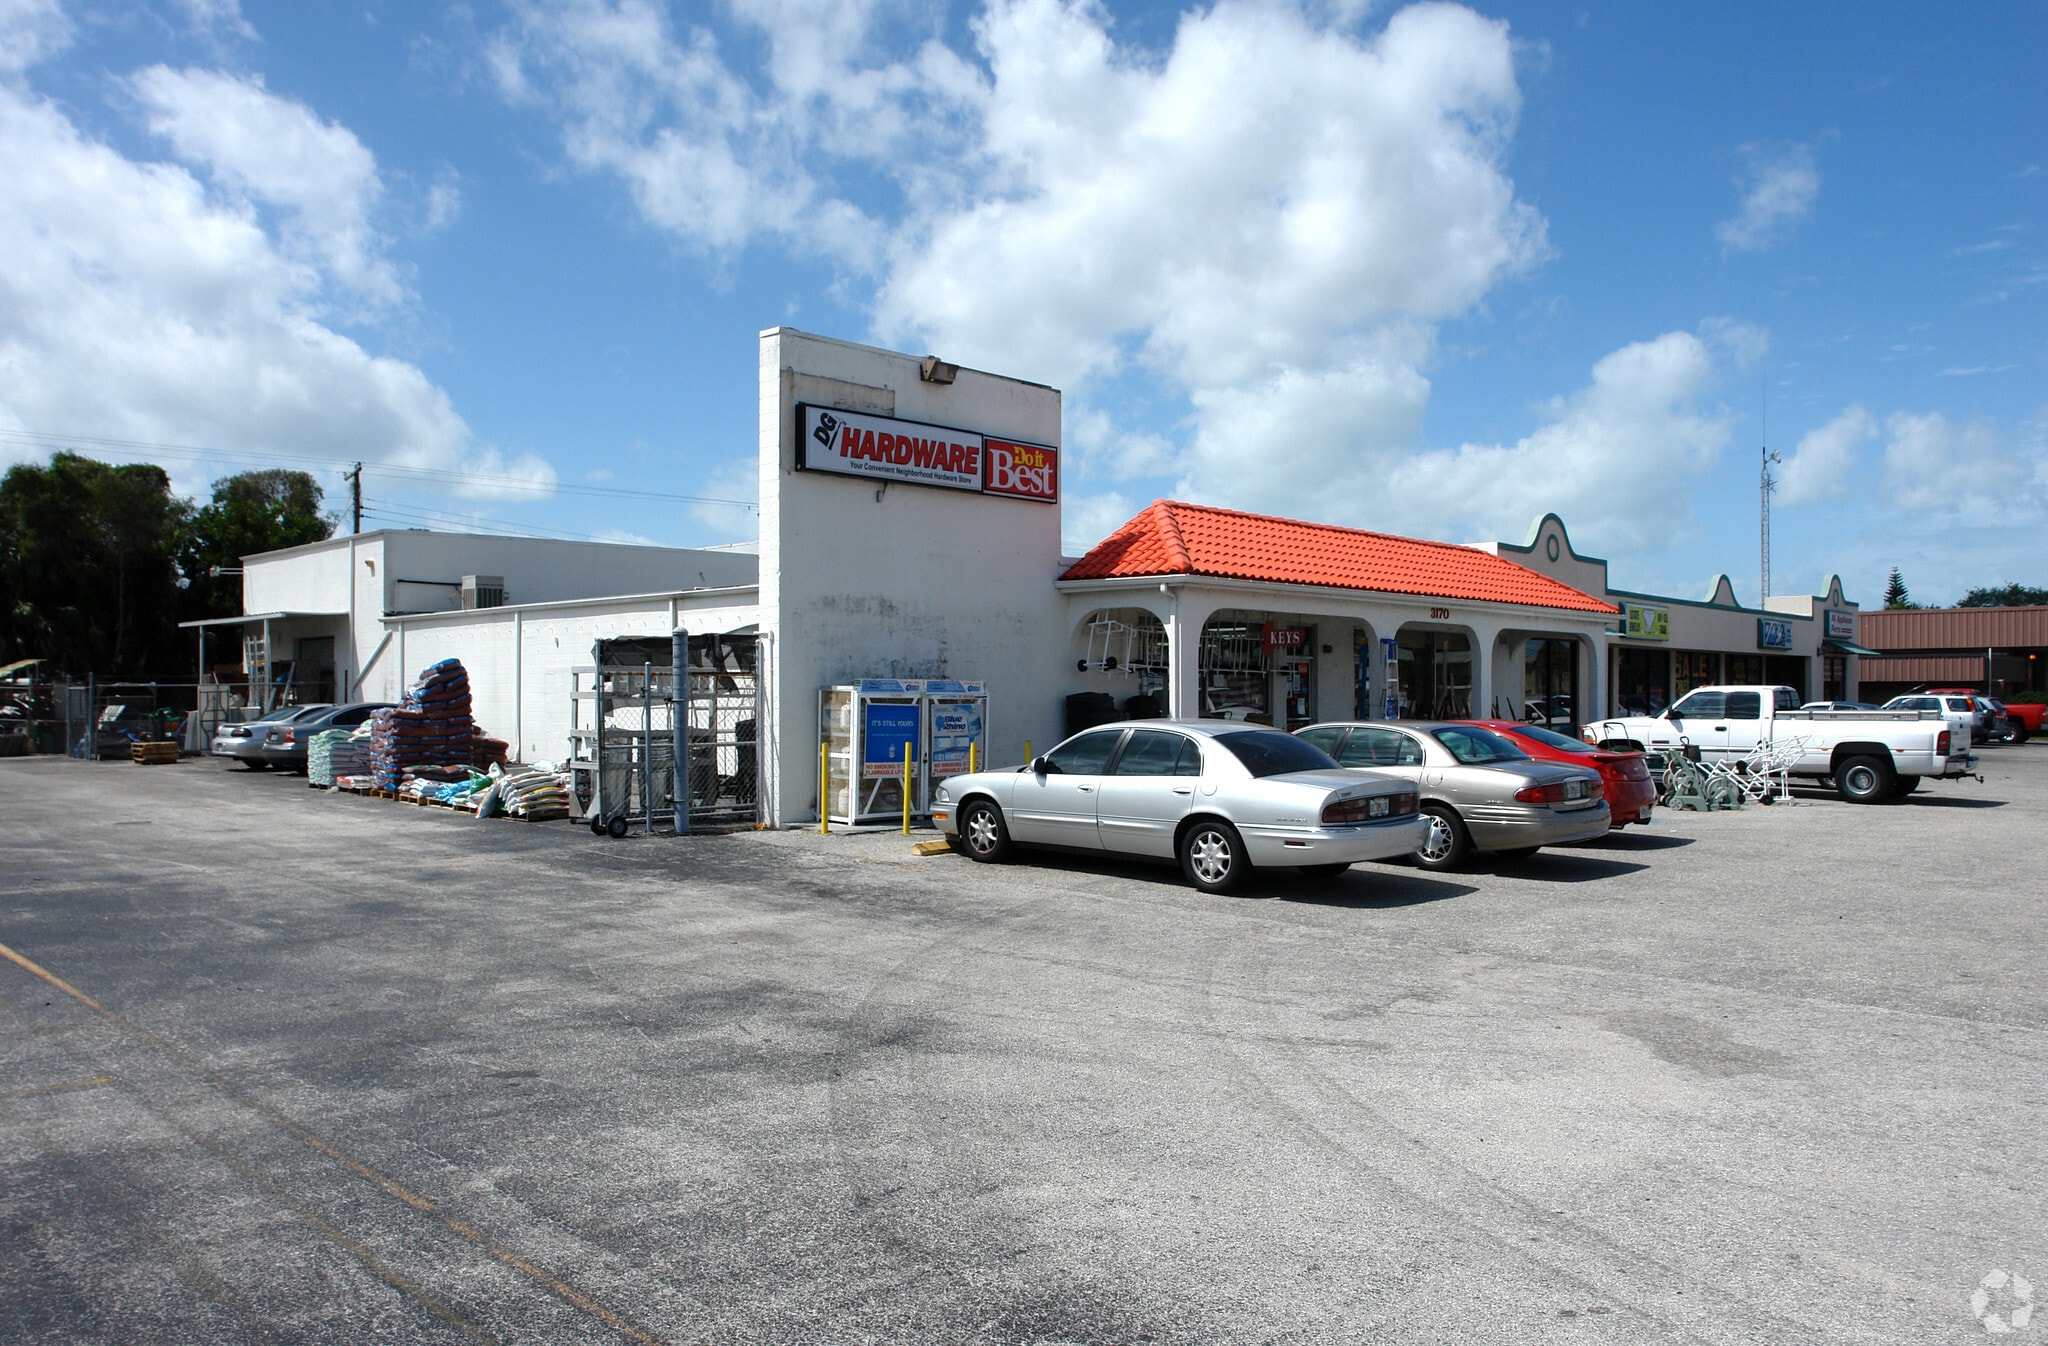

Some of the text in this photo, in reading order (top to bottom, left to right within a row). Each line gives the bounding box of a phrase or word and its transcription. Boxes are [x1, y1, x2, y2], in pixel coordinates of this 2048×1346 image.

[813, 412, 838, 447] DG
[839, 426, 980, 476] HARDWARE
[1013, 446, 1044, 468] Do it
[849, 461, 972, 484] Your Convenient Neighborhood Hardware Store
[989, 448, 1054, 495] Best
[1430, 607, 1450, 620] 3170
[1270, 631, 1300, 645] KEYS
[1675, 651, 1708, 678] SALE
[943, 722, 967, 730] Rhino
[944, 715, 963, 723] Blue
